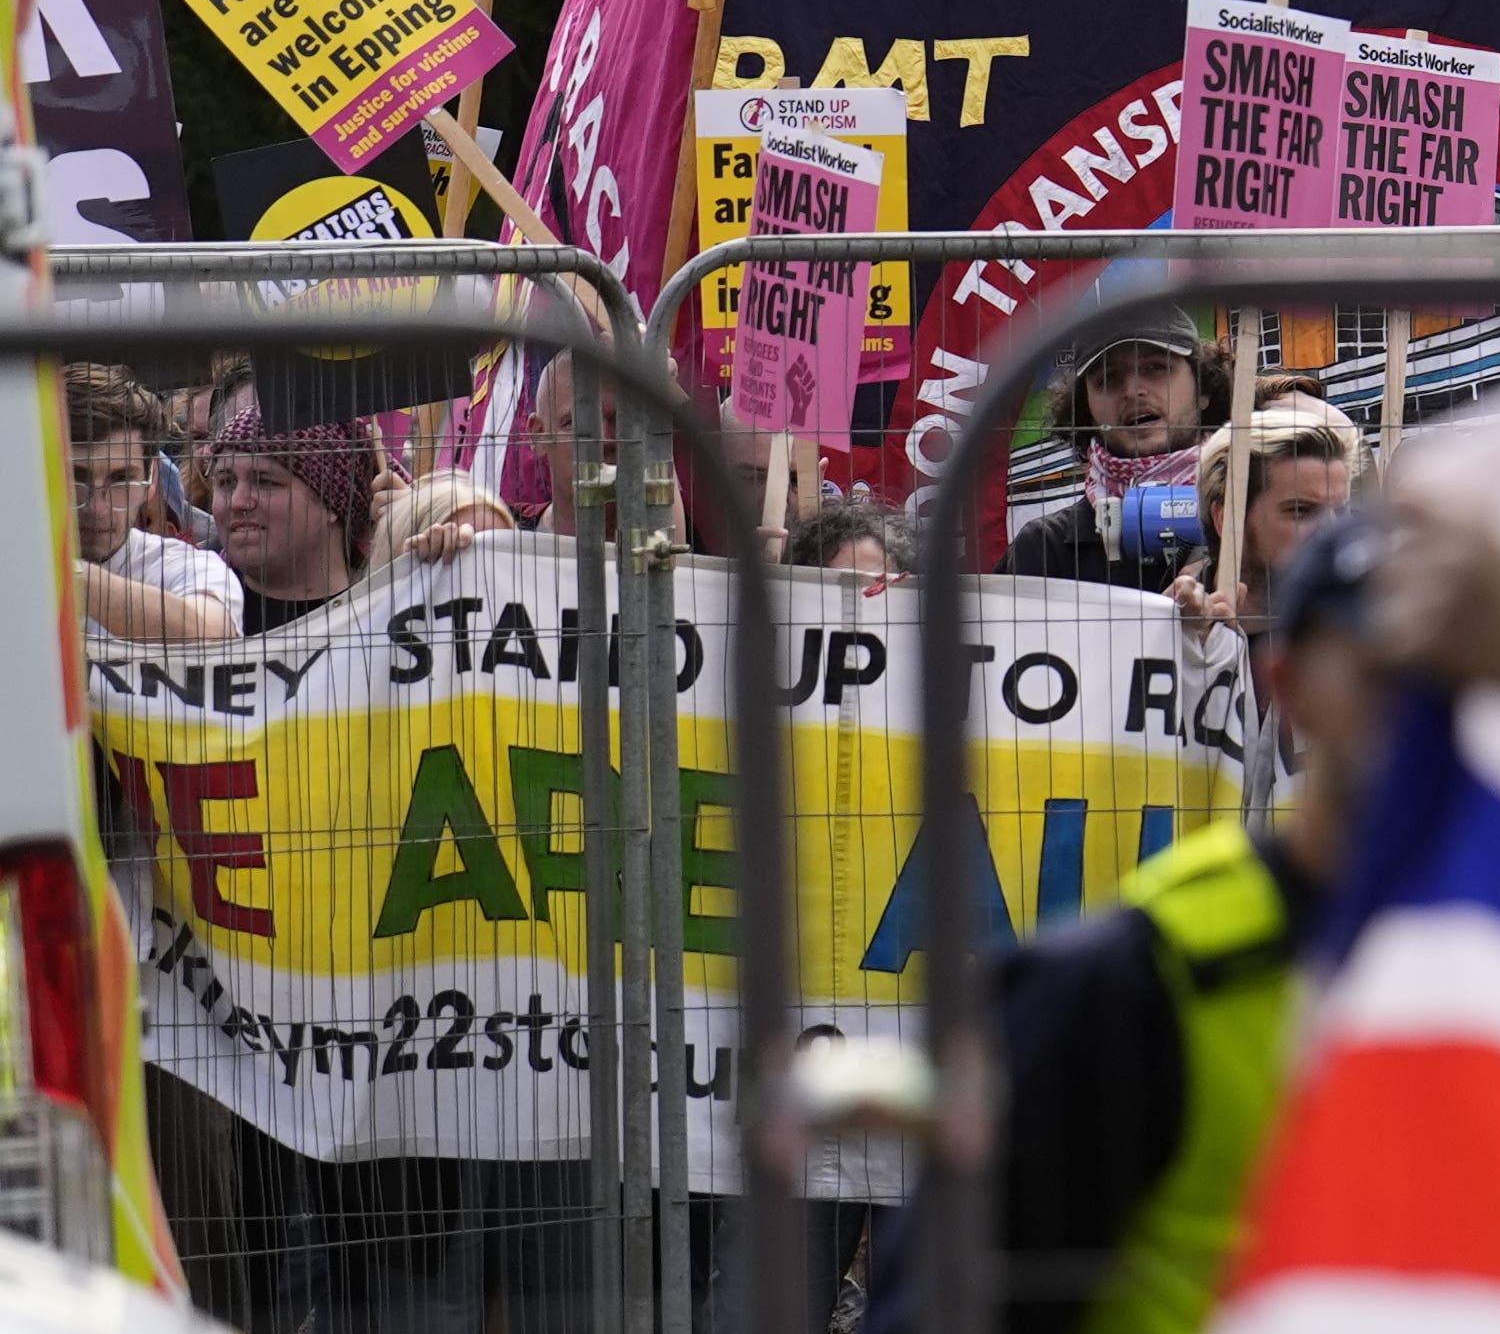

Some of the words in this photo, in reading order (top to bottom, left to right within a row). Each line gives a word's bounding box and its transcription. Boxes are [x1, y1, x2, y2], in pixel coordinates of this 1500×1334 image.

[291, 75, 339, 113] in
[333, 89, 394, 143] Justice
[389, 65, 418, 92] for
[416, 25, 480, 72] victims
[779, 100, 824, 113] STAND
[830, 99, 849, 113] UP
[1203, 40, 1315, 108] SMASH
[1344, 71, 1465, 133] SMASH
[348, 129, 384, 160] and
[381, 71, 458, 133] survivors
[1201, 97, 1270, 156] THE
[1277, 109, 1323, 168] FAR
[713, 143, 760, 178] Fa
[1342, 122, 1409, 175] THE
[1419, 132, 1480, 186] FAR
[715, 197, 752, 223] ar
[758, 161, 849, 234] SMASH
[1194, 154, 1295, 219] RIGHT
[1338, 174, 1444, 227] RIGHT
[746, 276, 825, 345] RIGHT
